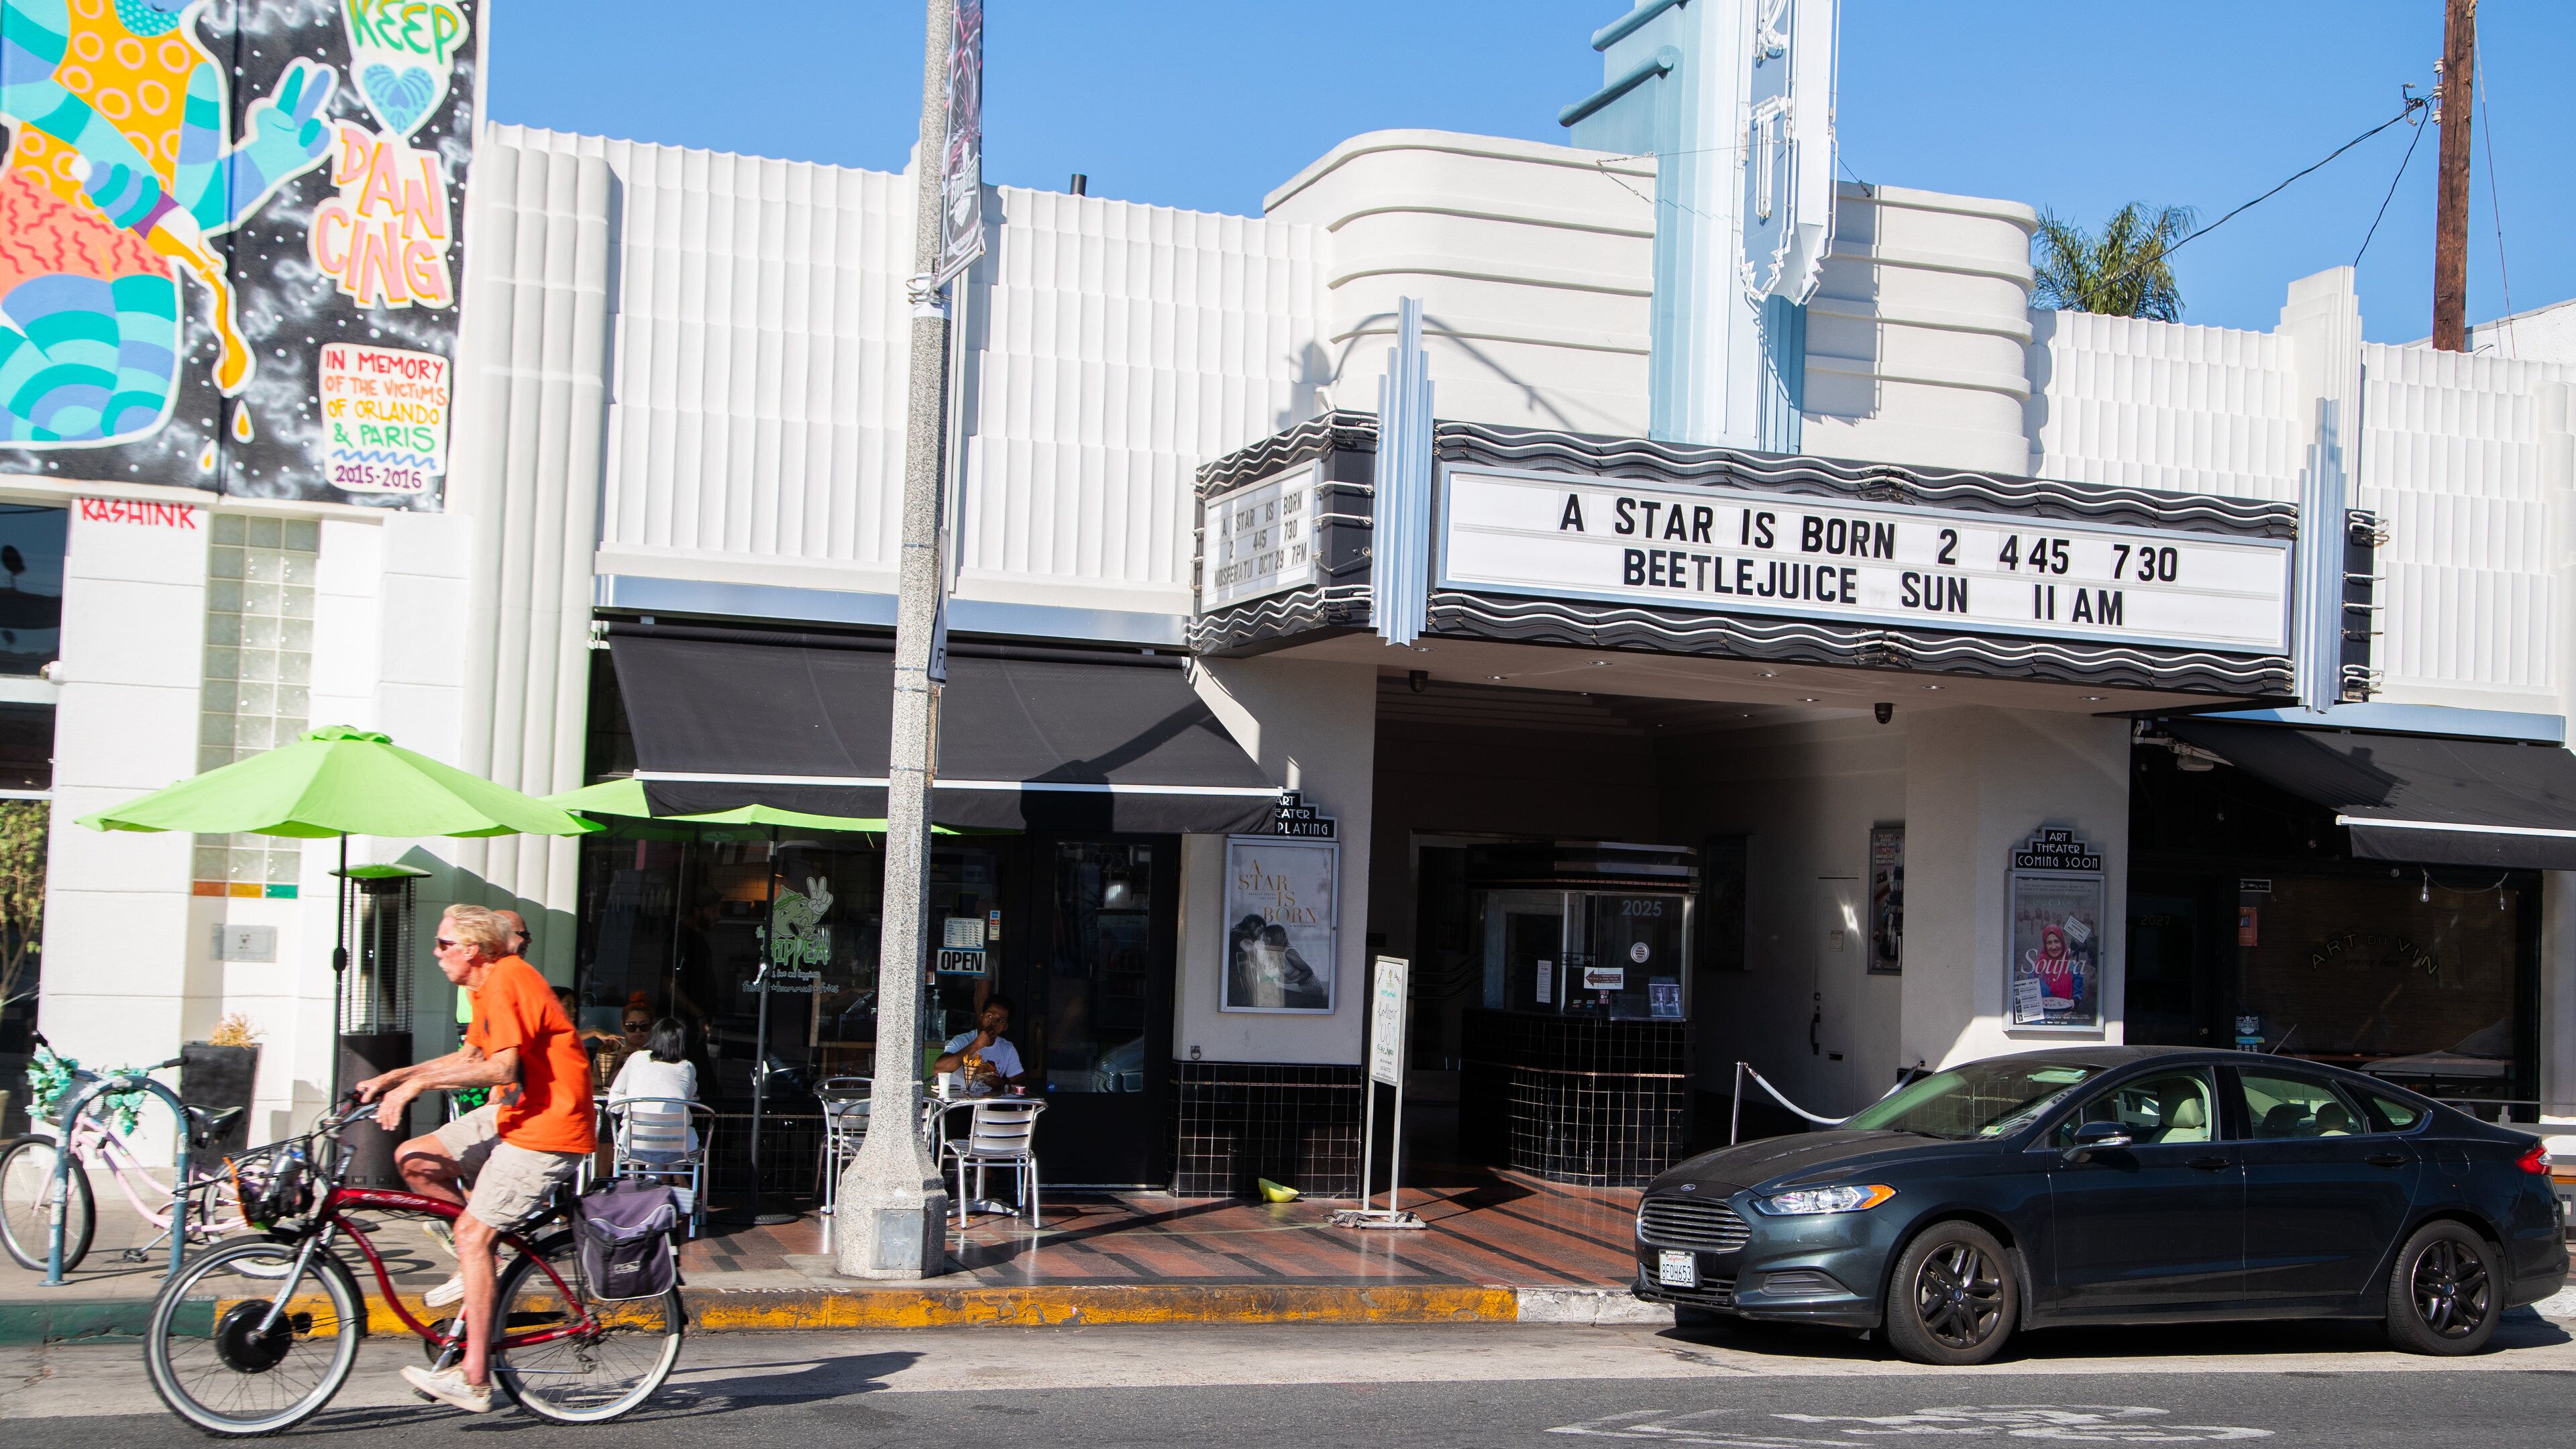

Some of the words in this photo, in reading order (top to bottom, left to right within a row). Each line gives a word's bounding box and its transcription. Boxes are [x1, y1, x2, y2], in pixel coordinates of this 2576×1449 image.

[347, 0, 458, 64] KEEP
[326, 350, 345, 370] IN
[358, 352, 443, 383] MEMORY
[325, 376, 345, 393] OF
[350, 377, 378, 396] THE
[327, 398, 346, 417] OF
[355, 400, 439, 425] ORLANDO
[334, 423, 354, 448] &
[360, 424, 435, 453] PARIS
[335, 464, 422, 488] 2015-2016
[80, 496, 195, 529] KASHINK
[1222, 519, 1228, 537] A
[1236, 508, 1254, 532] STAR
[1266, 501, 1273, 522] IS
[1283, 490, 1302, 516] BORN
[1230, 543, 1234, 559] 2
[1253, 530, 1267, 549] 445
[1284, 520, 1297, 542] 730
[1560, 494, 1585, 532] A
[1615, 497, 1713, 544] STAR
[1741, 508, 1776, 549] IS
[1802, 515, 1895, 559] BORN
[1937, 529, 1957, 566] 2
[1214, 559, 1253, 588] NOSFERATU
[1258, 553, 1272, 575] OCT
[1275, 550, 1284, 570] 29
[1291, 542, 1307, 565] 7PM
[1624, 548, 1857, 604] BEETLEJUICE
[1901, 572, 1968, 613] SUN
[2072, 588, 2123, 626] AM
[1275, 796, 1295, 806] ART
[1275, 808, 1309, 819] EATER
[1277, 822, 1328, 835] PLAYING
[2049, 833, 2068, 841] ART
[2036, 843, 2080, 854] THEATER
[1248, 859, 1261, 874] A
[2018, 855, 2058, 867] COMING
[2065, 857, 2098, 868] SOON
[1238, 874, 1288, 891] STAR
[1277, 891, 1295, 907] IS
[1621, 900, 1662, 917] 2025
[1262, 907, 1318, 924] BORN
[2141, 915, 2171, 926] 2027
[941, 951, 982, 971] OPEN
[2311, 932, 2358, 971] ART
[2367, 935, 2388, 945] DU
[2398, 937, 2439, 975] VIN
[2021, 948, 2088, 981] Soufra
[776, 981, 813, 993] hummus
[819, 982, 839, 994] fries
